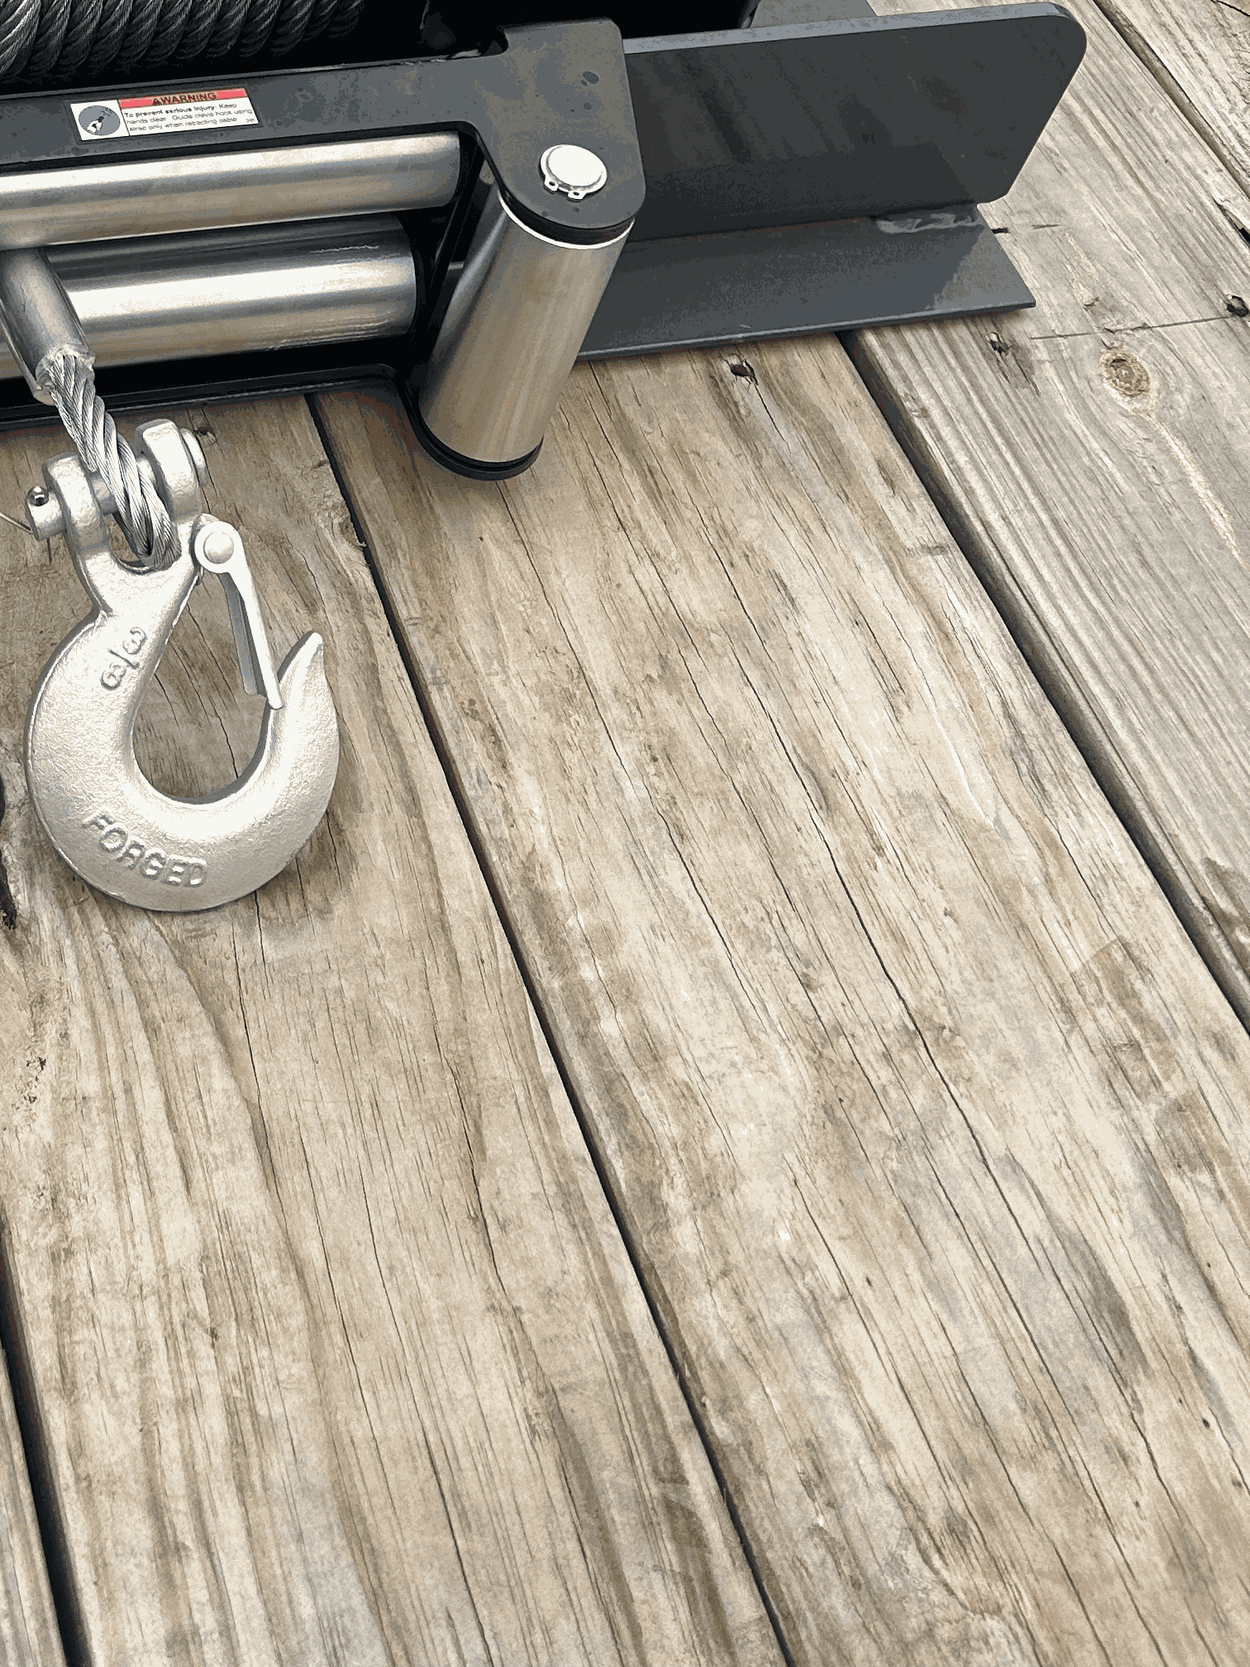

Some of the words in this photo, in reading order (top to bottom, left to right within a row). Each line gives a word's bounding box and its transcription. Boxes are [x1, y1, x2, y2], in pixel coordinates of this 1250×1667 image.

[159, 91, 217, 104] WARNING
[135, 109, 164, 118] prevent
[81, 807, 208, 889] FORGED
